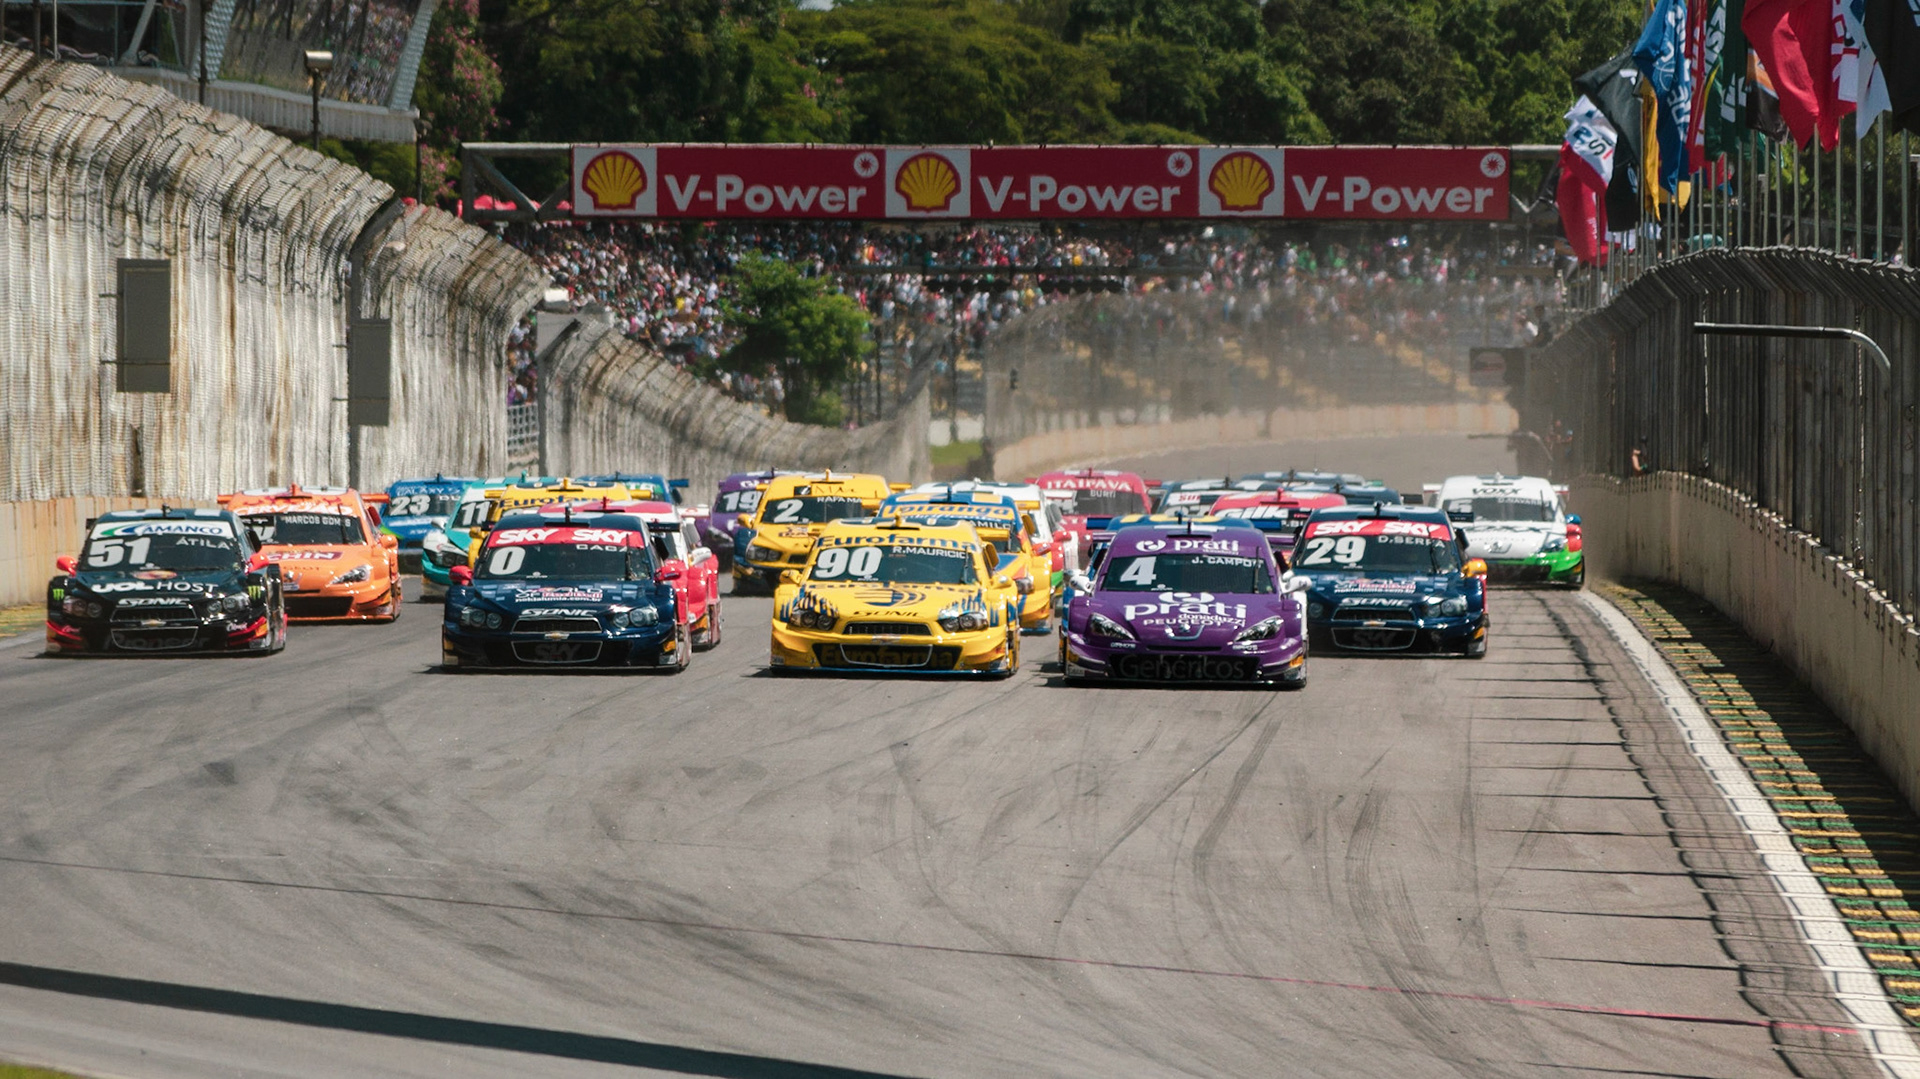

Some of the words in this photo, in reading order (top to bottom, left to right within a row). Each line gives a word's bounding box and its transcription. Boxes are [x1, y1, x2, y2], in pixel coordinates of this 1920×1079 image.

[664, 174, 867, 213] V-Power
[979, 175, 1181, 213] V-Power
[1292, 175, 1494, 214] V-Power
[1046, 479, 1131, 491] ITAIPAVA
[1472, 487, 1521, 495] VOXX
[390, 494, 431, 516] 23
[723, 491, 763, 512] 19
[461, 501, 490, 526] 11
[774, 499, 803, 523] 2
[888, 505, 1010, 516] Ipiranga
[141, 524, 223, 534] AMANCO
[285, 515, 320, 525] MARCOS
[322, 517, 351, 527] GOMS
[1314, 521, 1373, 536] SKY
[1382, 521, 1440, 536] SKY
[176, 536, 231, 550] ÁTILA
[496, 528, 559, 544] SKY
[571, 529, 632, 544] SKY
[817, 534, 977, 550] Eurofarma
[87, 537, 151, 567] 51
[1175, 539, 1239, 551] prati
[1303, 536, 1366, 565] 29
[489, 546, 526, 575] 0
[815, 547, 882, 578] 90
[1192, 556, 1203, 564] J.
[1120, 556, 1157, 585] 4
[156, 581, 219, 593] HOST
[1123, 602, 1247, 620] prati
[1143, 618, 1222, 627] PEUGEOT
[1178, 613, 1246, 627] donaduzzi
[1119, 654, 1244, 679] Genéricos
